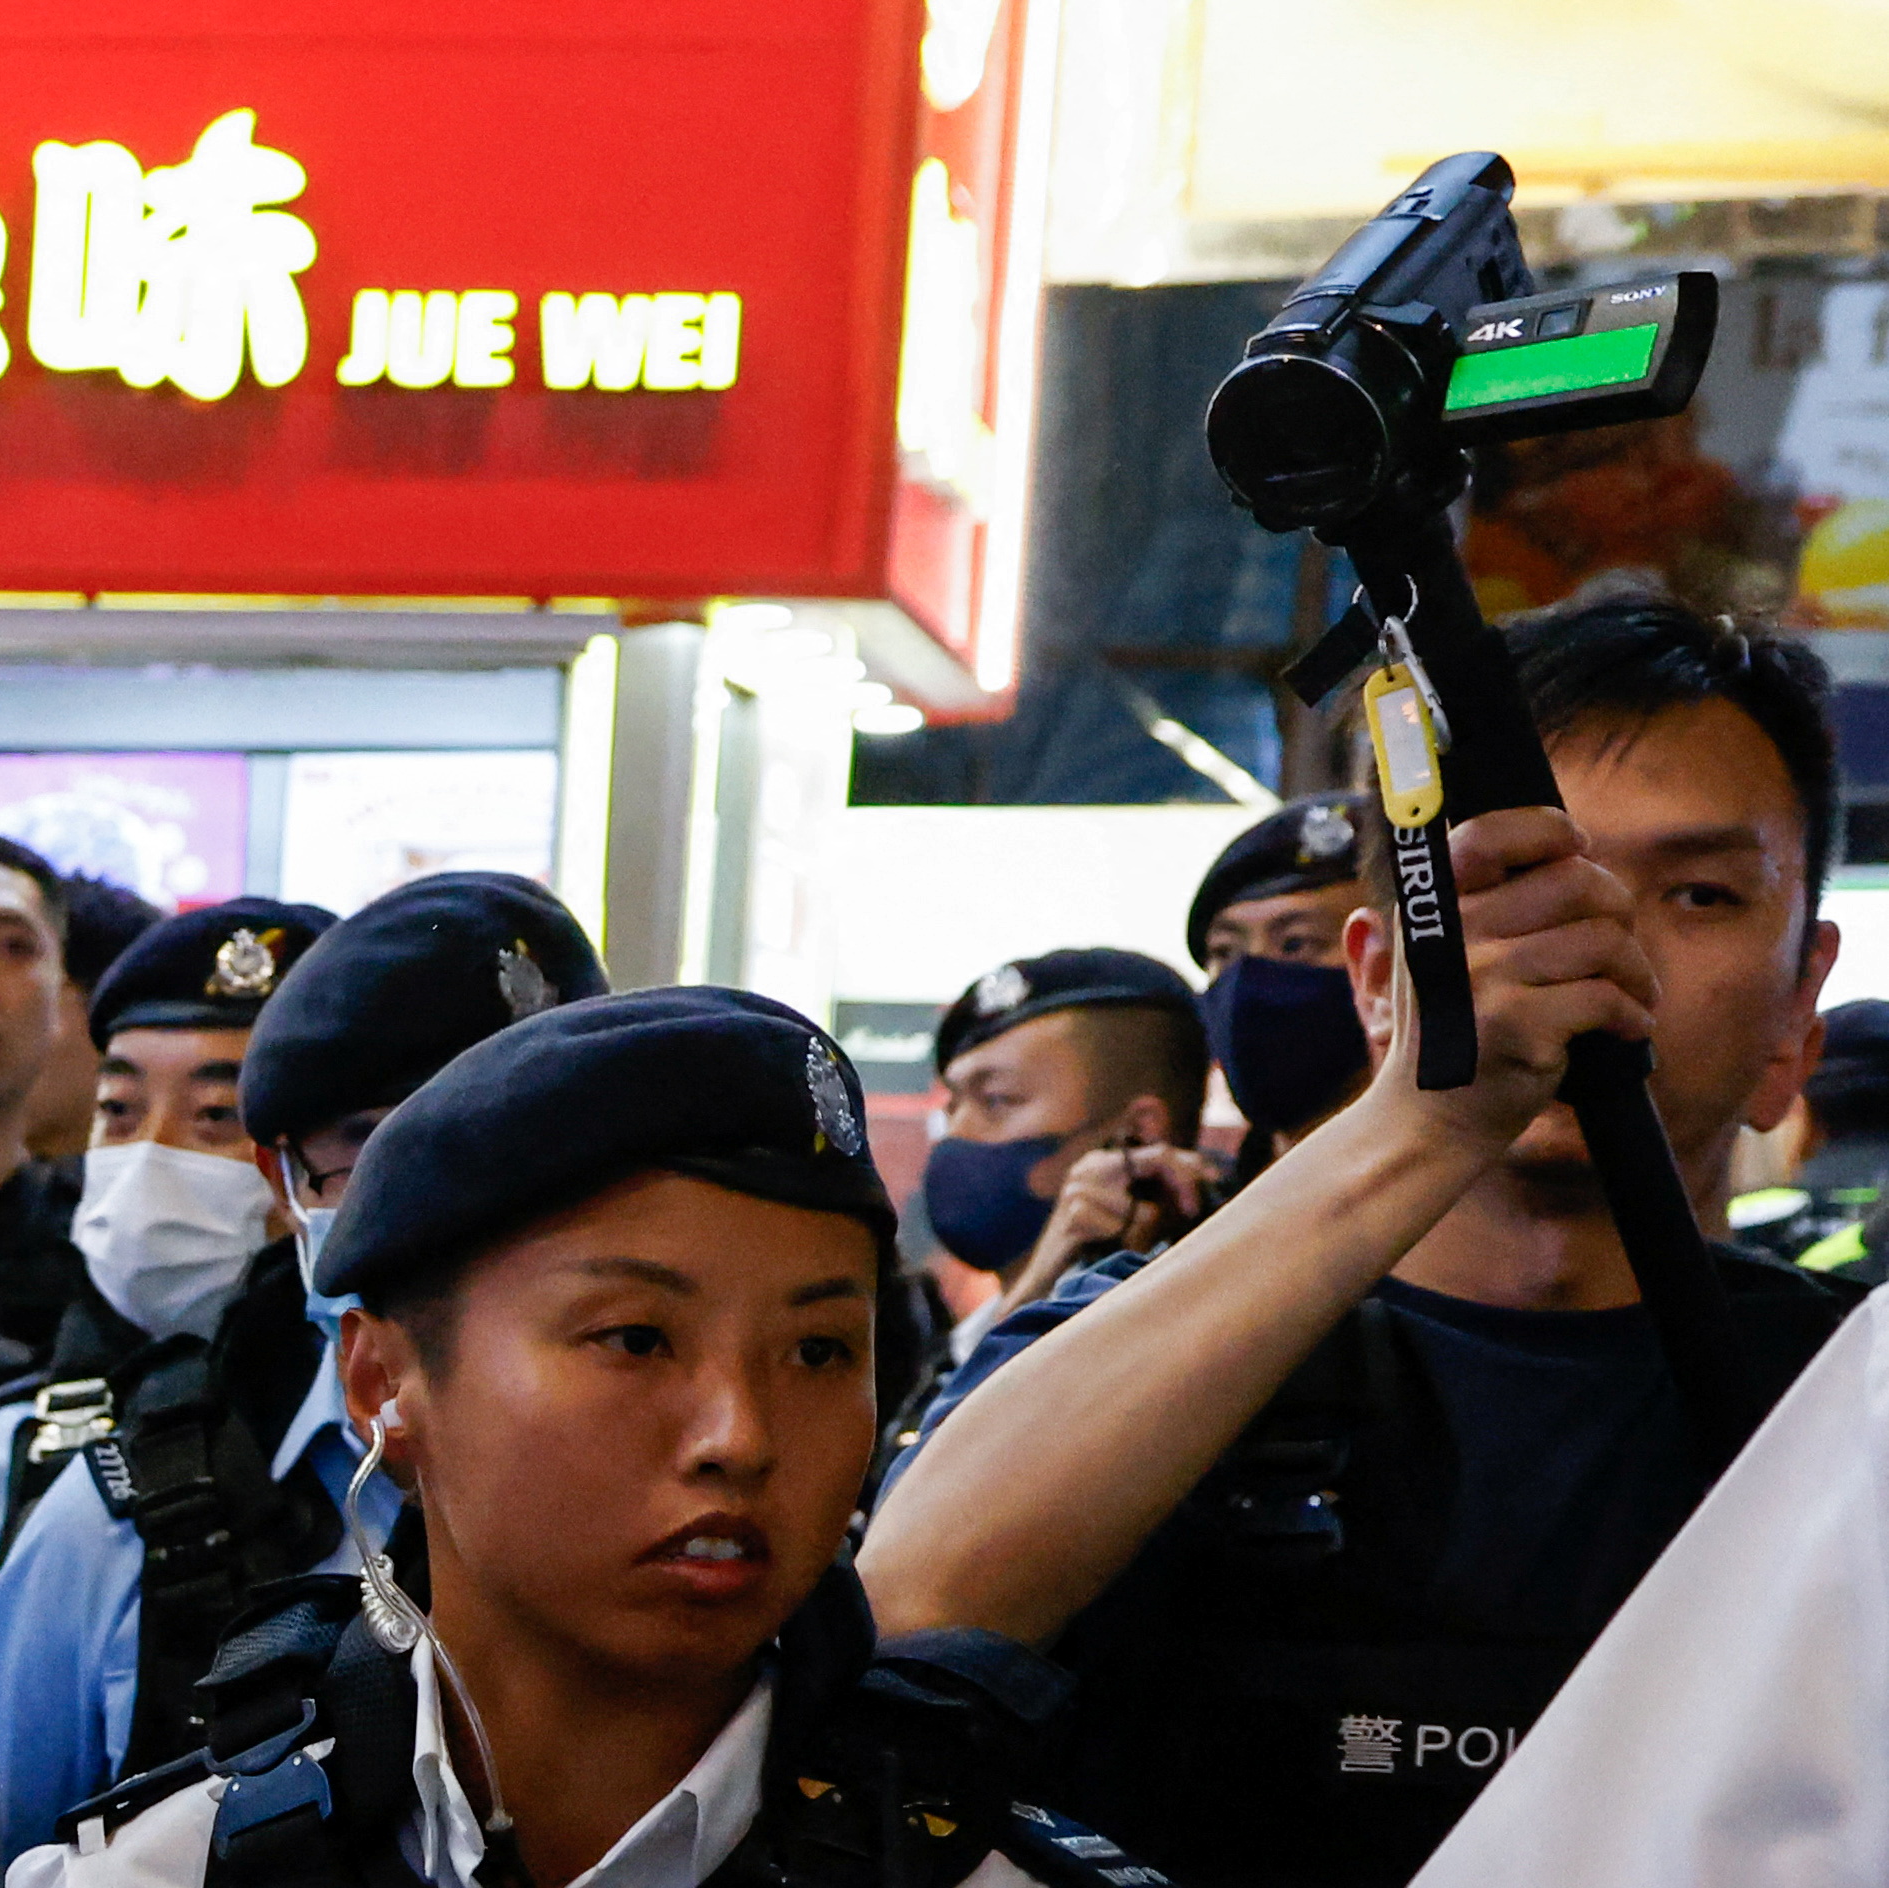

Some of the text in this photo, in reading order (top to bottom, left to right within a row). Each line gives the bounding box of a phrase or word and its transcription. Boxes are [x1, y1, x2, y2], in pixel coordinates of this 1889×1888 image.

[1609, 284, 1667, 305] SONY
[336, 288, 519, 389] JUE
[540, 289, 741, 392] WEI
[1466, 317, 1525, 343] 4K
[1393, 826, 1445, 943] SIRUI
[1336, 1713, 1404, 1775] 警
